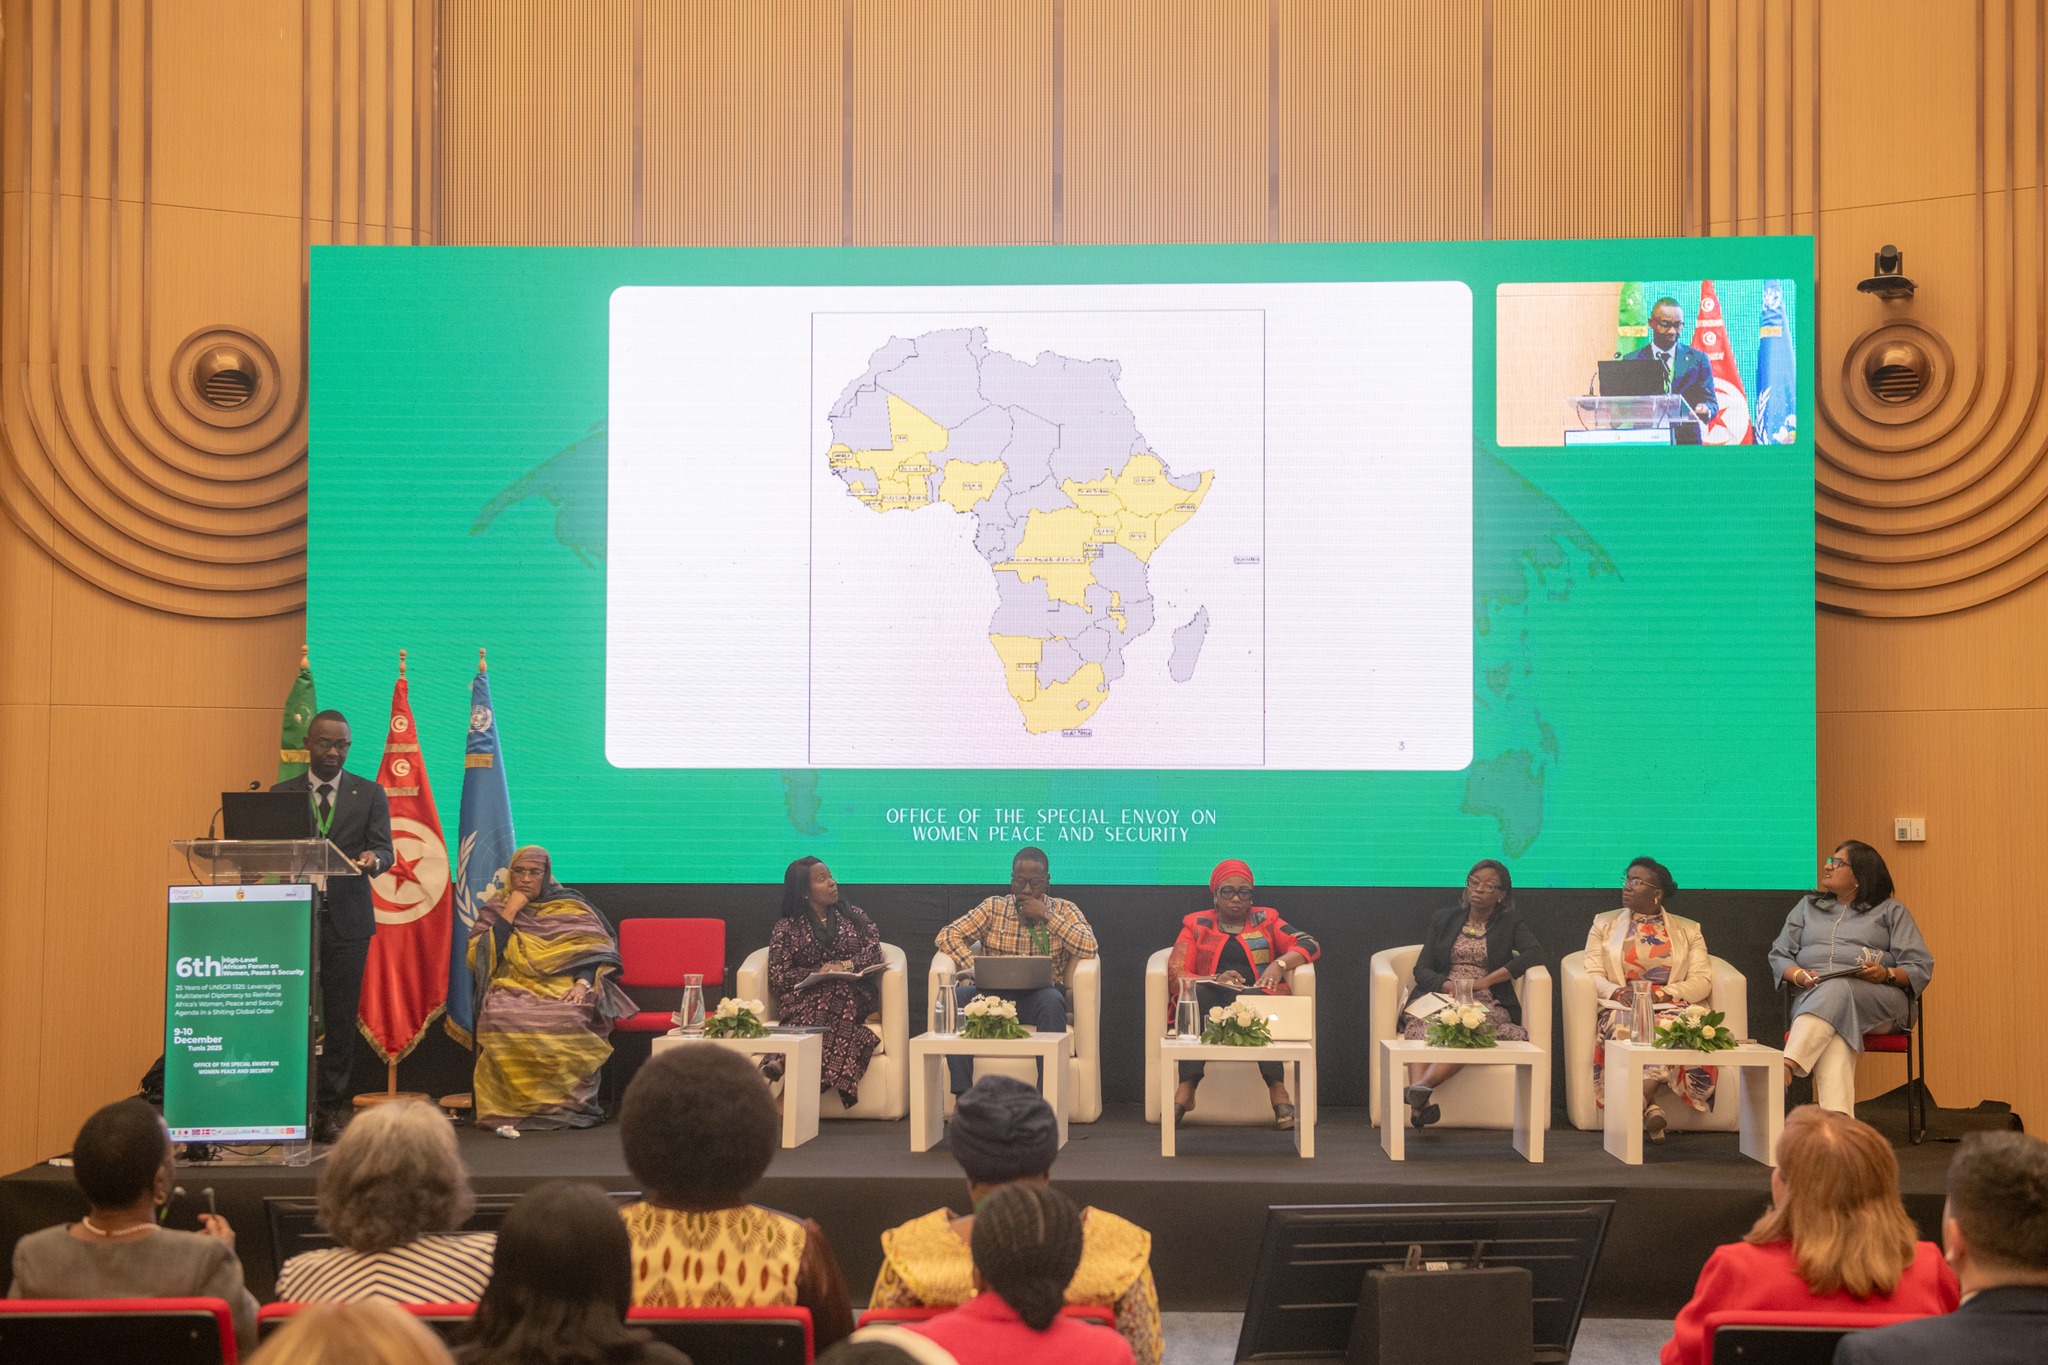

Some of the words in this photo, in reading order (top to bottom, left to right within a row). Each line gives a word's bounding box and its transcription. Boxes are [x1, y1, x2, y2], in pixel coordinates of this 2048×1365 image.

[1399, 741, 1405, 751] 3
[886, 808, 947, 824] OFFICE
[959, 808, 981, 824] OF
[994, 808, 1025, 824] THE
[1037, 808, 1109, 824] SPECIAL
[1121, 809, 1180, 825] ENVOY
[1191, 809, 1216, 825] ON
[912, 826, 978, 842] WOMEN
[989, 826, 1045, 842] PEACE
[1058, 826, 1094, 842] AND
[1105, 827, 1189, 842] SECURITY
[176, 955, 221, 977] 6th
[247, 983, 282, 991] Leveraging
[258, 999, 284, 1007] Security
[174, 1009, 200, 1017] Agenda
[174, 1027, 193, 1036] 9-10
[174, 1035, 223, 1044] December
